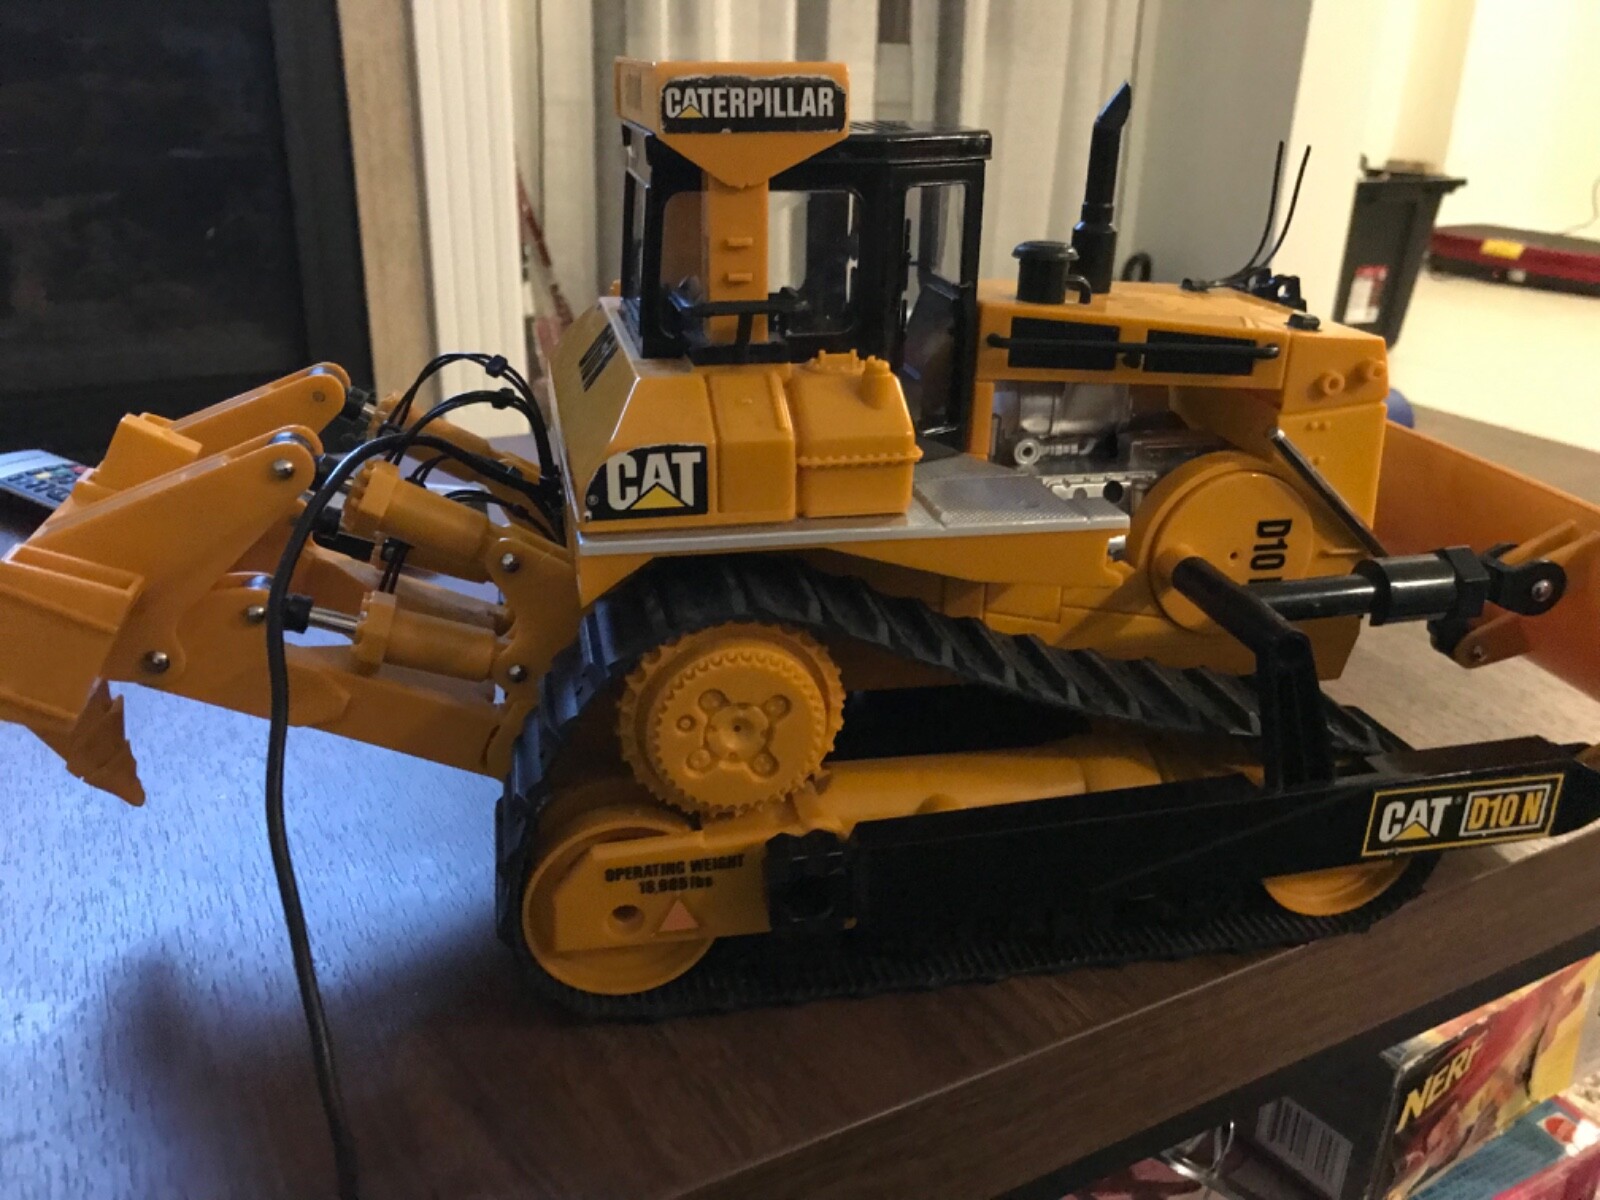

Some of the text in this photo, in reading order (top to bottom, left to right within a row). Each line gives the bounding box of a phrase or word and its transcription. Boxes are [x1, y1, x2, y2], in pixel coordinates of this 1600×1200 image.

[664, 86, 834, 118] CATERPILLAR
[606, 451, 702, 511] CAT
[1248, 519, 1292, 583] D10
[1378, 791, 1544, 842] CAT D10 N
[604, 854, 745, 882] OPERATING WEIGHT
[1395, 1030, 1488, 1134] NERF
